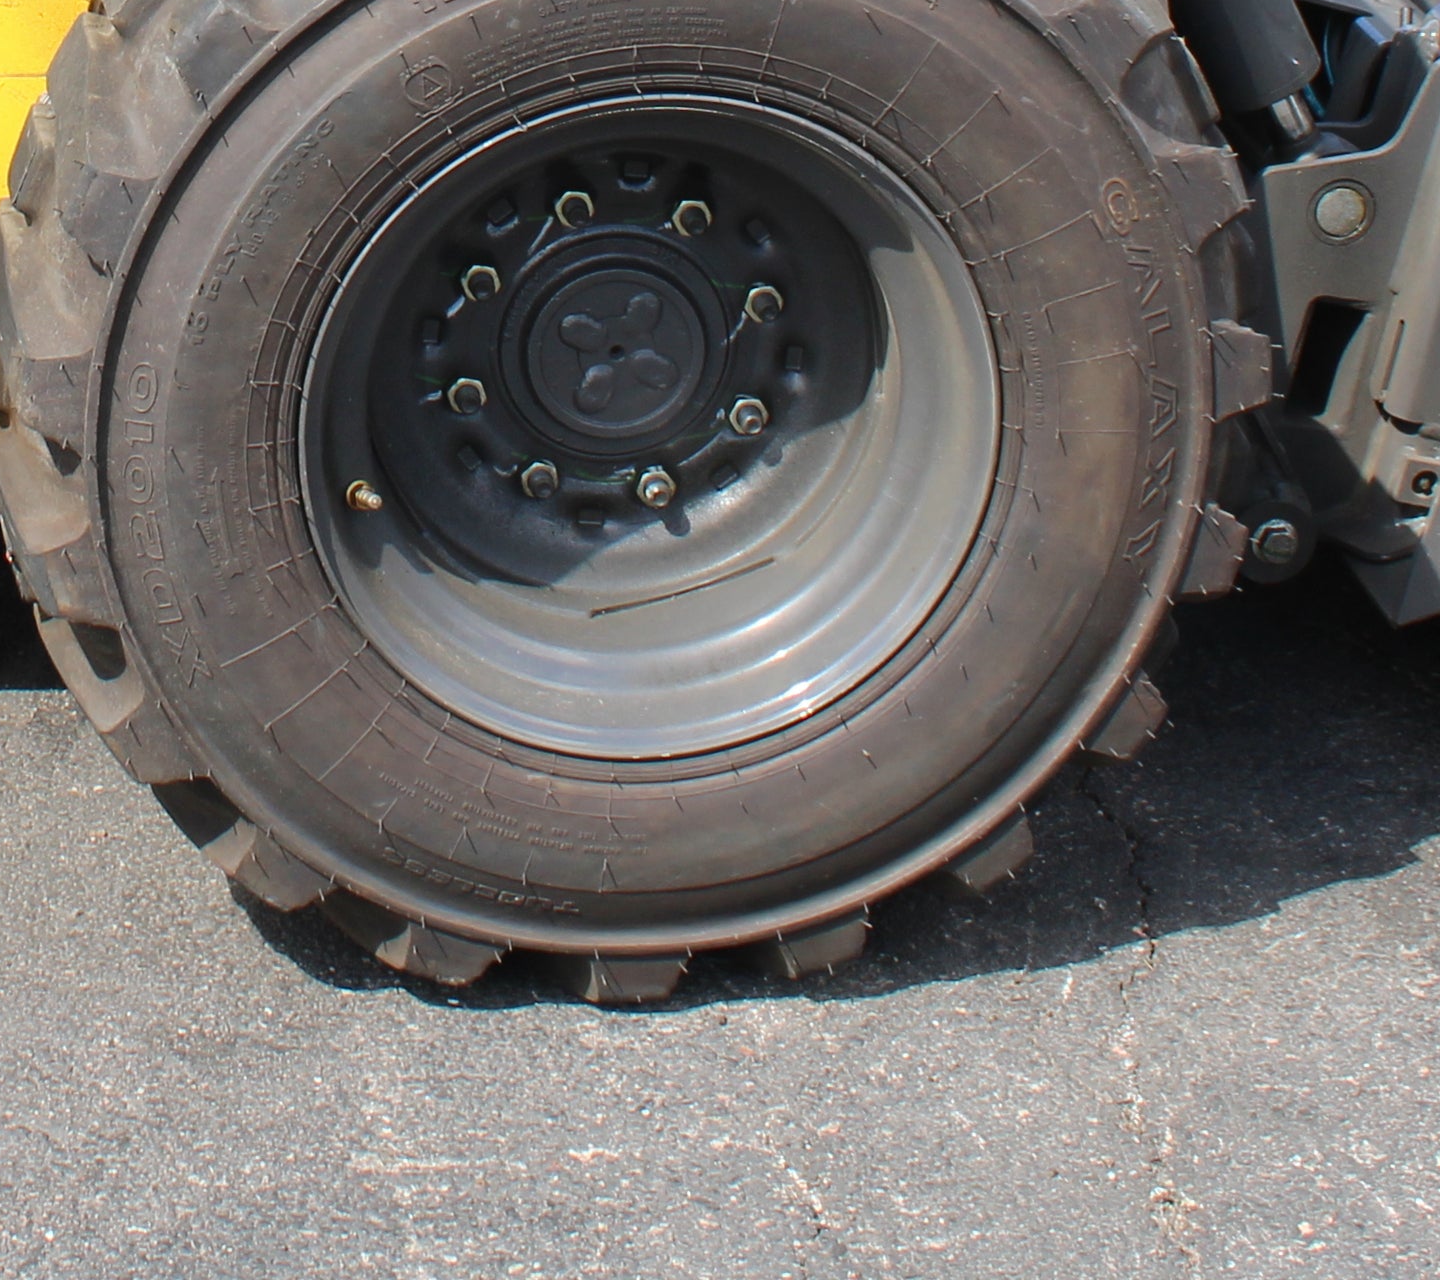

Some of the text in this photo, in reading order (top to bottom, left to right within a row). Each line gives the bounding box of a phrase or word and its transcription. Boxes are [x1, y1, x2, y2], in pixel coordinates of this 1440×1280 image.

[241, 117, 335, 228] RATING
[121, 362, 213, 689] XD2010
[1100, 176, 1178, 580] GALAXY
